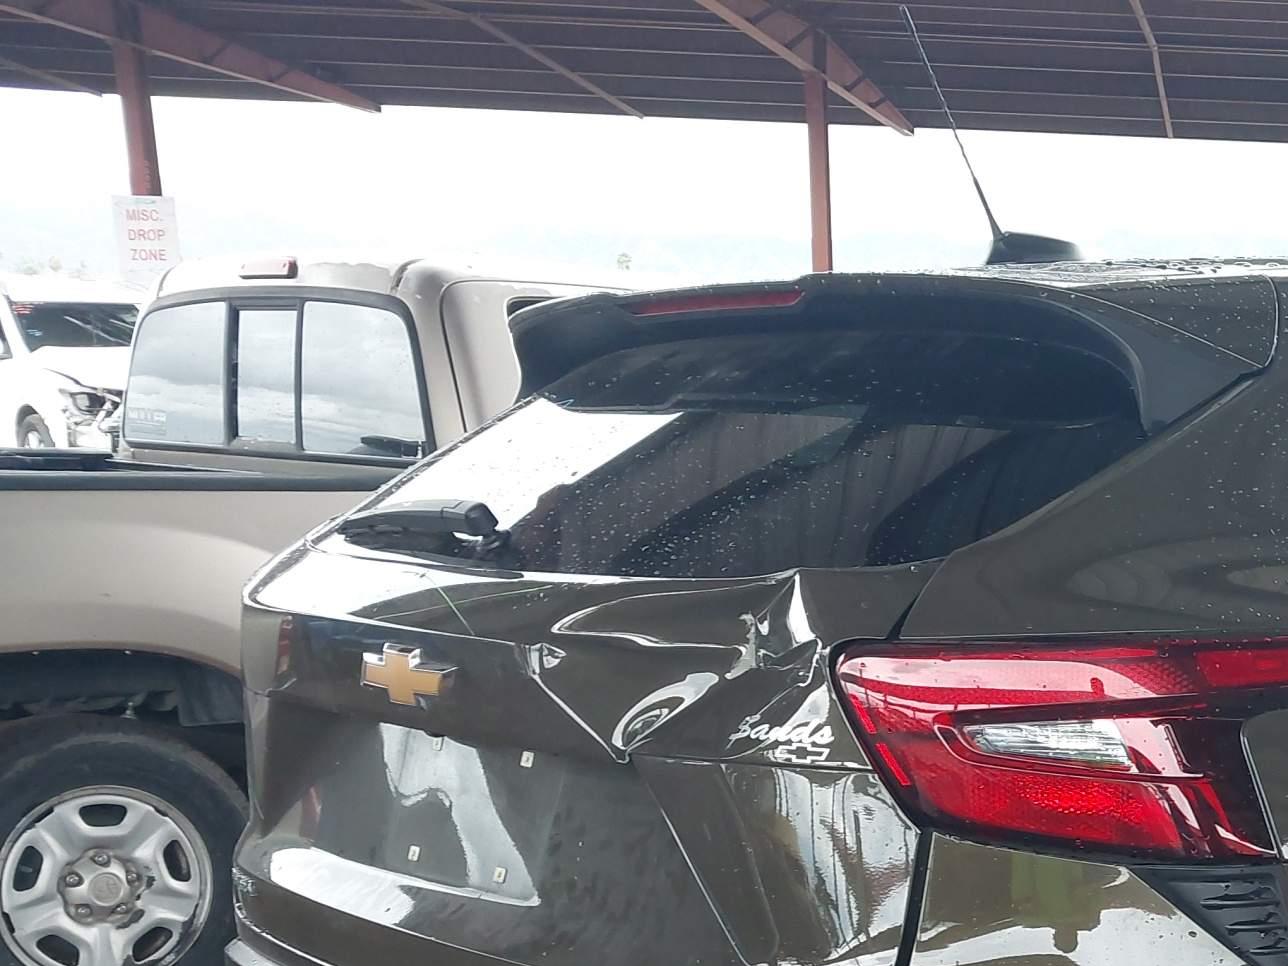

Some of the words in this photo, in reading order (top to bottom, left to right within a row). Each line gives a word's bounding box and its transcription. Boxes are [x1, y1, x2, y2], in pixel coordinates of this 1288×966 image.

[126, 208, 164, 222] MISC.
[127, 228, 166, 241] DROP
[129, 248, 168, 261] ZONE
